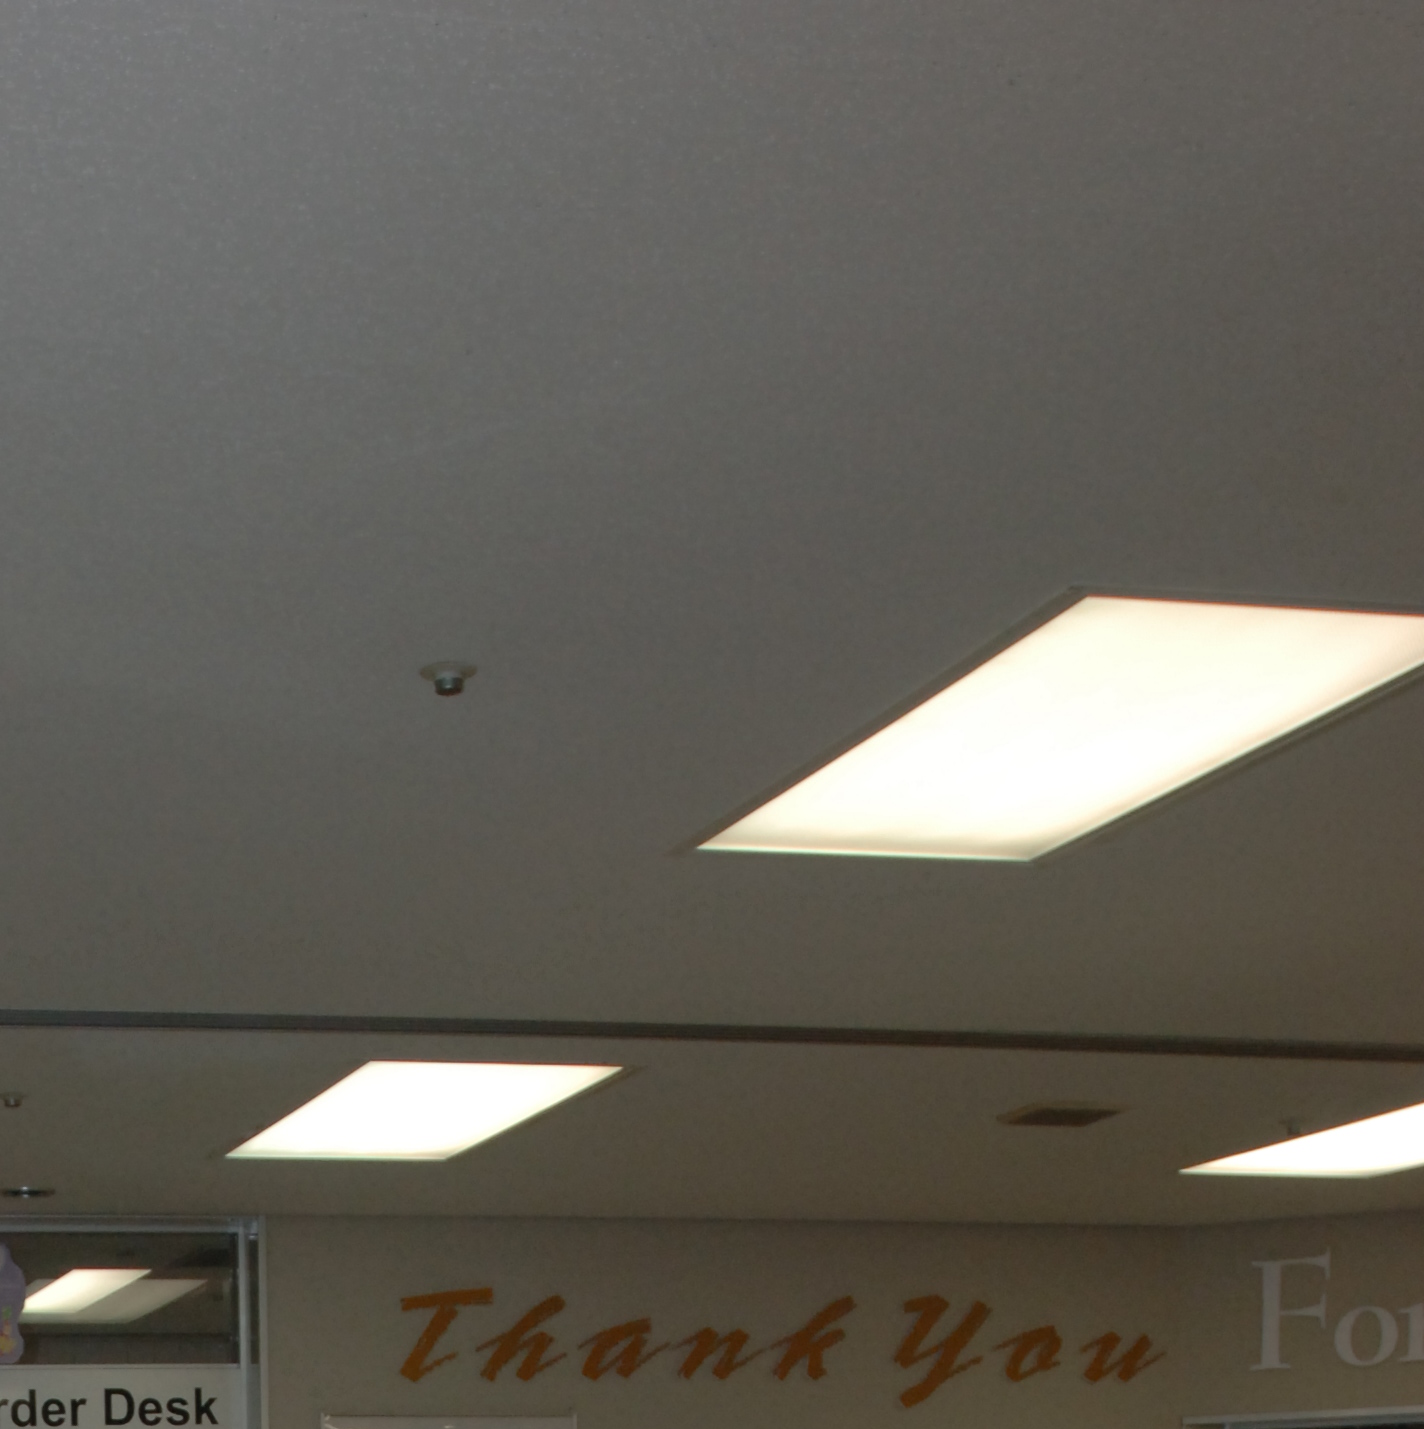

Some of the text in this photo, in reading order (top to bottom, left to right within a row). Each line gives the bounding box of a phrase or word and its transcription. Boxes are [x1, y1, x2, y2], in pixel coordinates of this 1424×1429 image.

[399, 1287, 1167, 1409] Thank You
[103, 1386, 219, 1427] Desk
